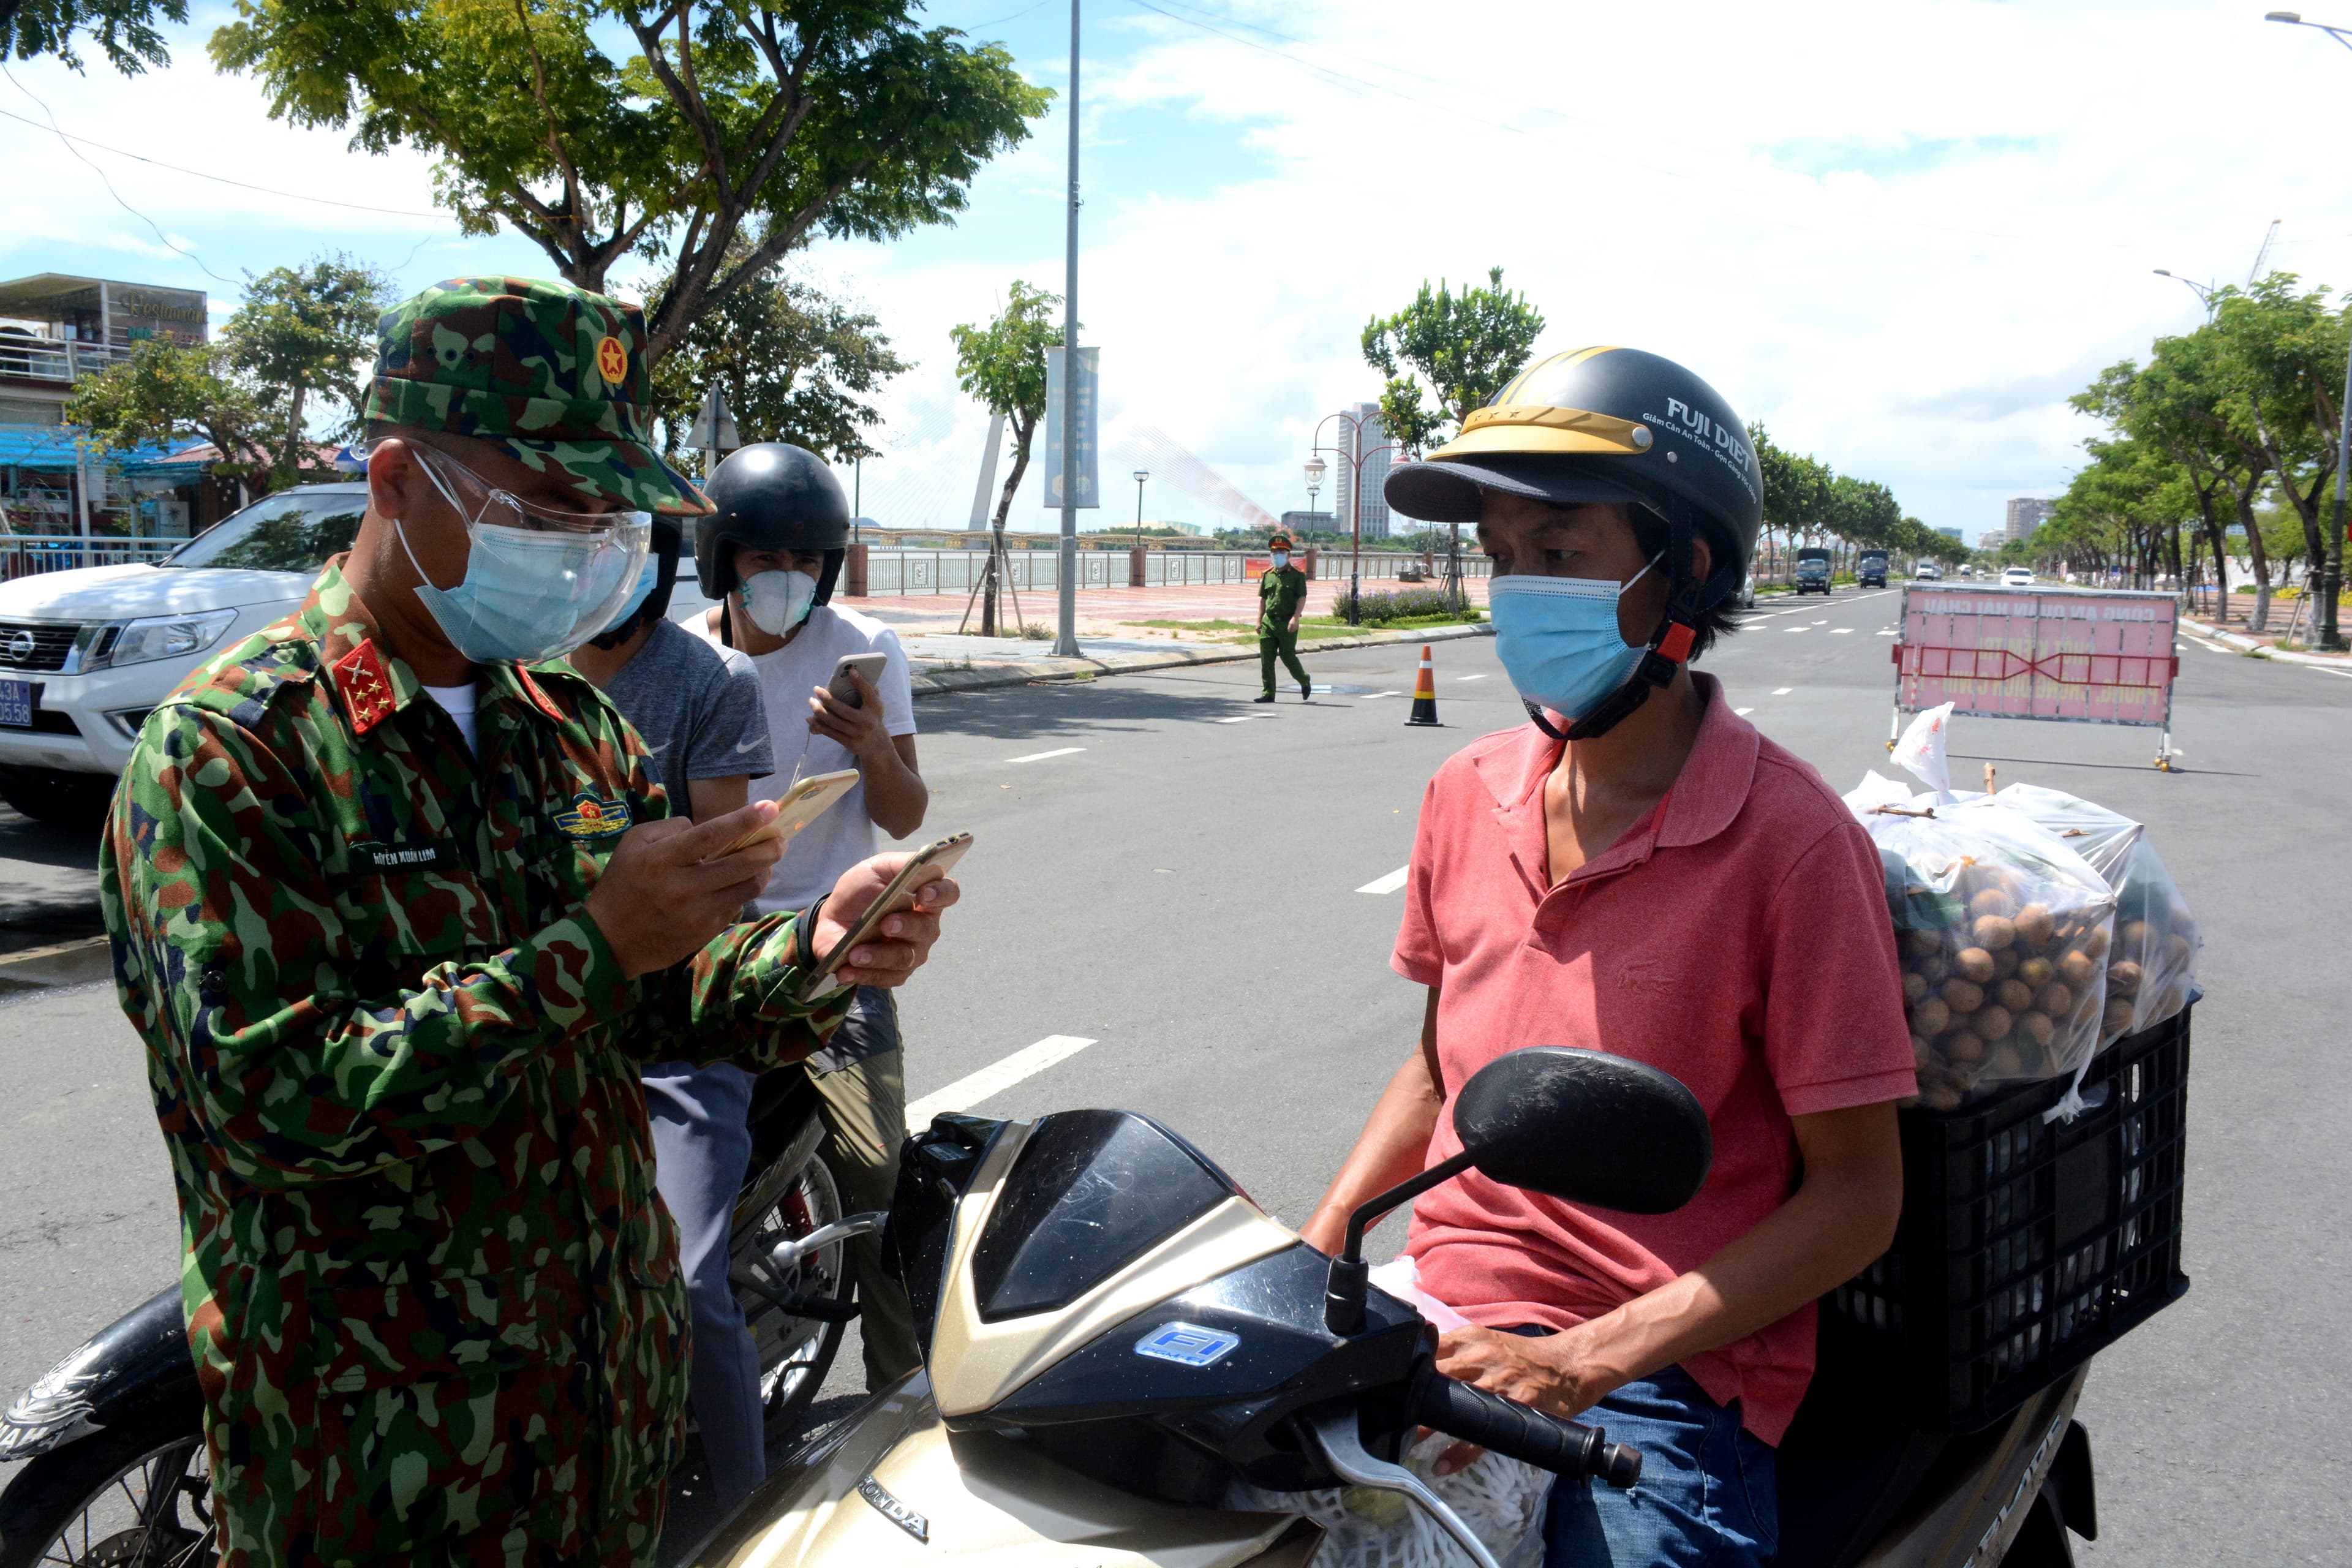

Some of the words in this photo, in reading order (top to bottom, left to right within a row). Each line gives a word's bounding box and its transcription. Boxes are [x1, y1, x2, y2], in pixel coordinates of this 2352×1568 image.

[1643, 412, 1665, 426] Giảm
[1665, 421, 1681, 434] Cân
[1682, 429, 1693, 440] An
[1714, 450, 1727, 464] Gọn
[1667, 397, 1710, 437] FUJI
[1715, 423, 1752, 472] DIET
[1140, 1347, 1205, 1363] PGM-FI
[1150, 1331, 1229, 1355] FI
[858, 1475, 927, 1538] HONDA
